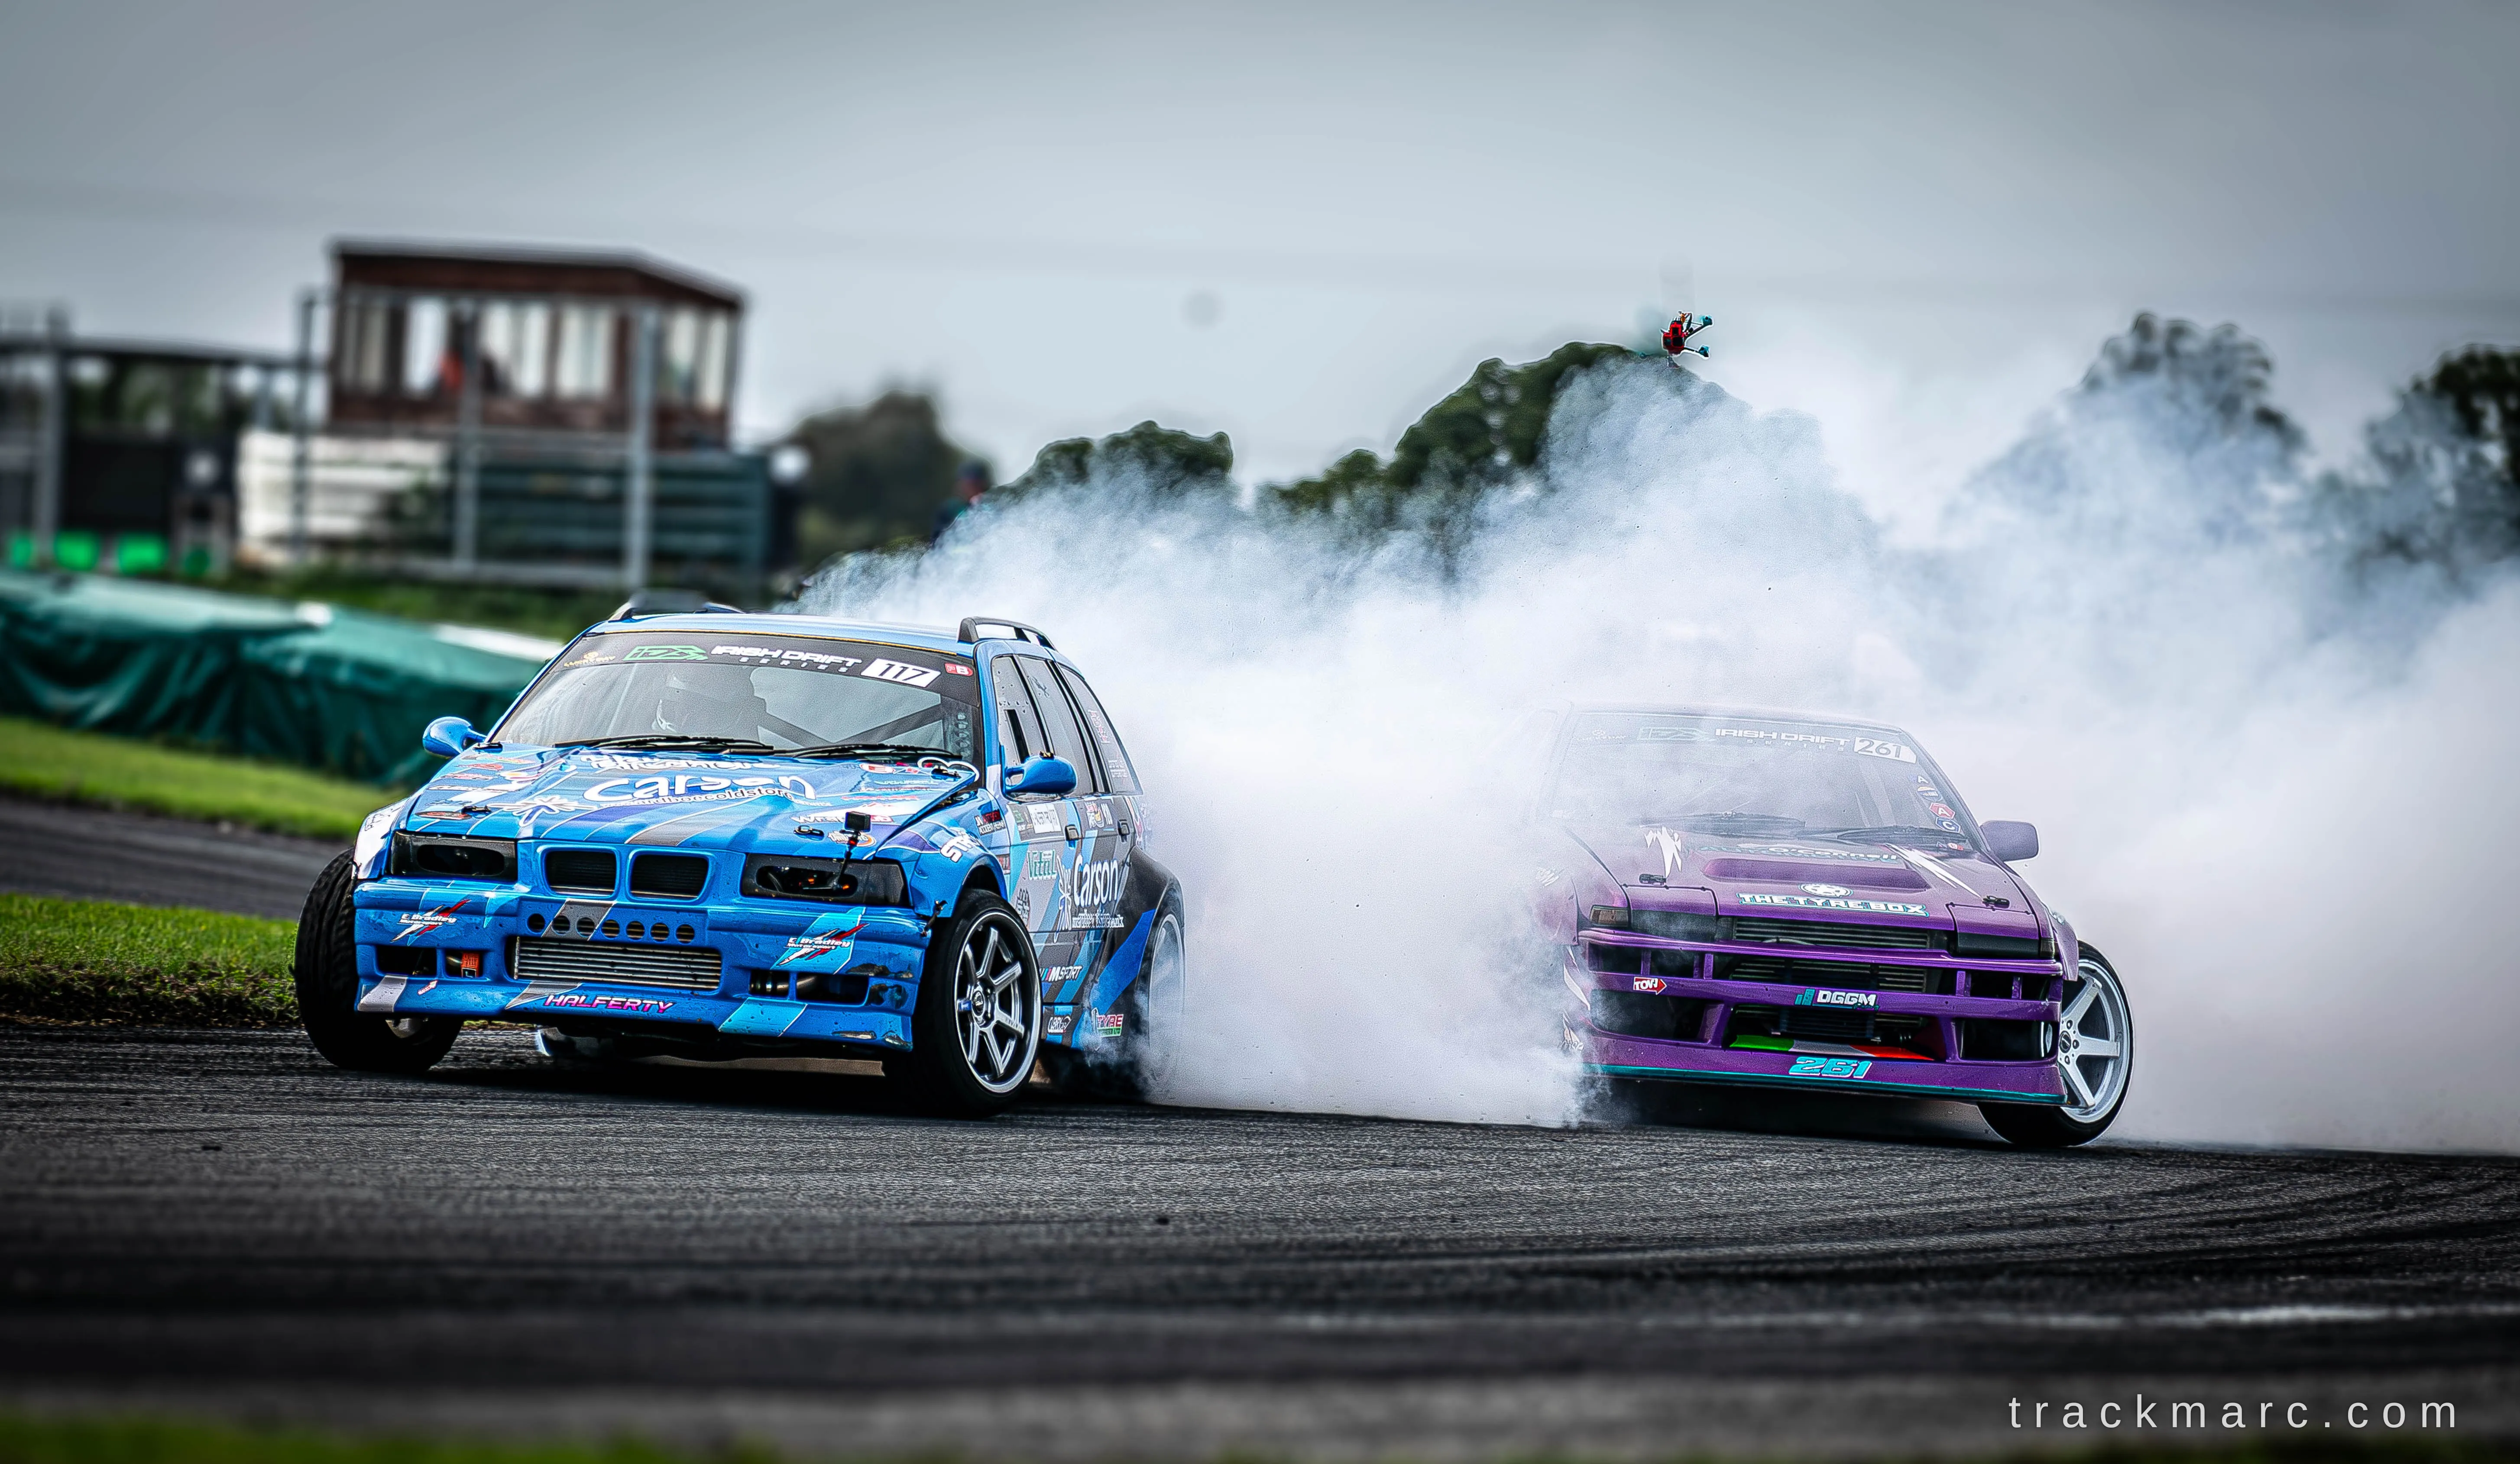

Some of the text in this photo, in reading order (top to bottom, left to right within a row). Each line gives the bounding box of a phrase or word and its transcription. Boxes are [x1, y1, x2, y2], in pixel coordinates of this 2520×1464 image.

[711, 645, 862, 667] IRISH DRIFT
[739, 656, 849, 672] SERIES
[878, 663, 930, 681] 117
[1715, 728, 1778, 739] IRISH
[1780, 732, 1851, 746] DRIFT
[1857, 739, 1902, 758] 261
[583, 775, 817, 801] Carson
[1073, 853, 1118, 908] Carson
[1738, 893, 1927, 915] THE TYRE BOX
[411, 914, 457, 924] Bradley
[800, 937, 851, 947] Bradley
[543, 994, 673, 1013] HALFERTY
[1817, 990, 1876, 1006] DGGM
[1788, 1056, 1872, 1079] 261
